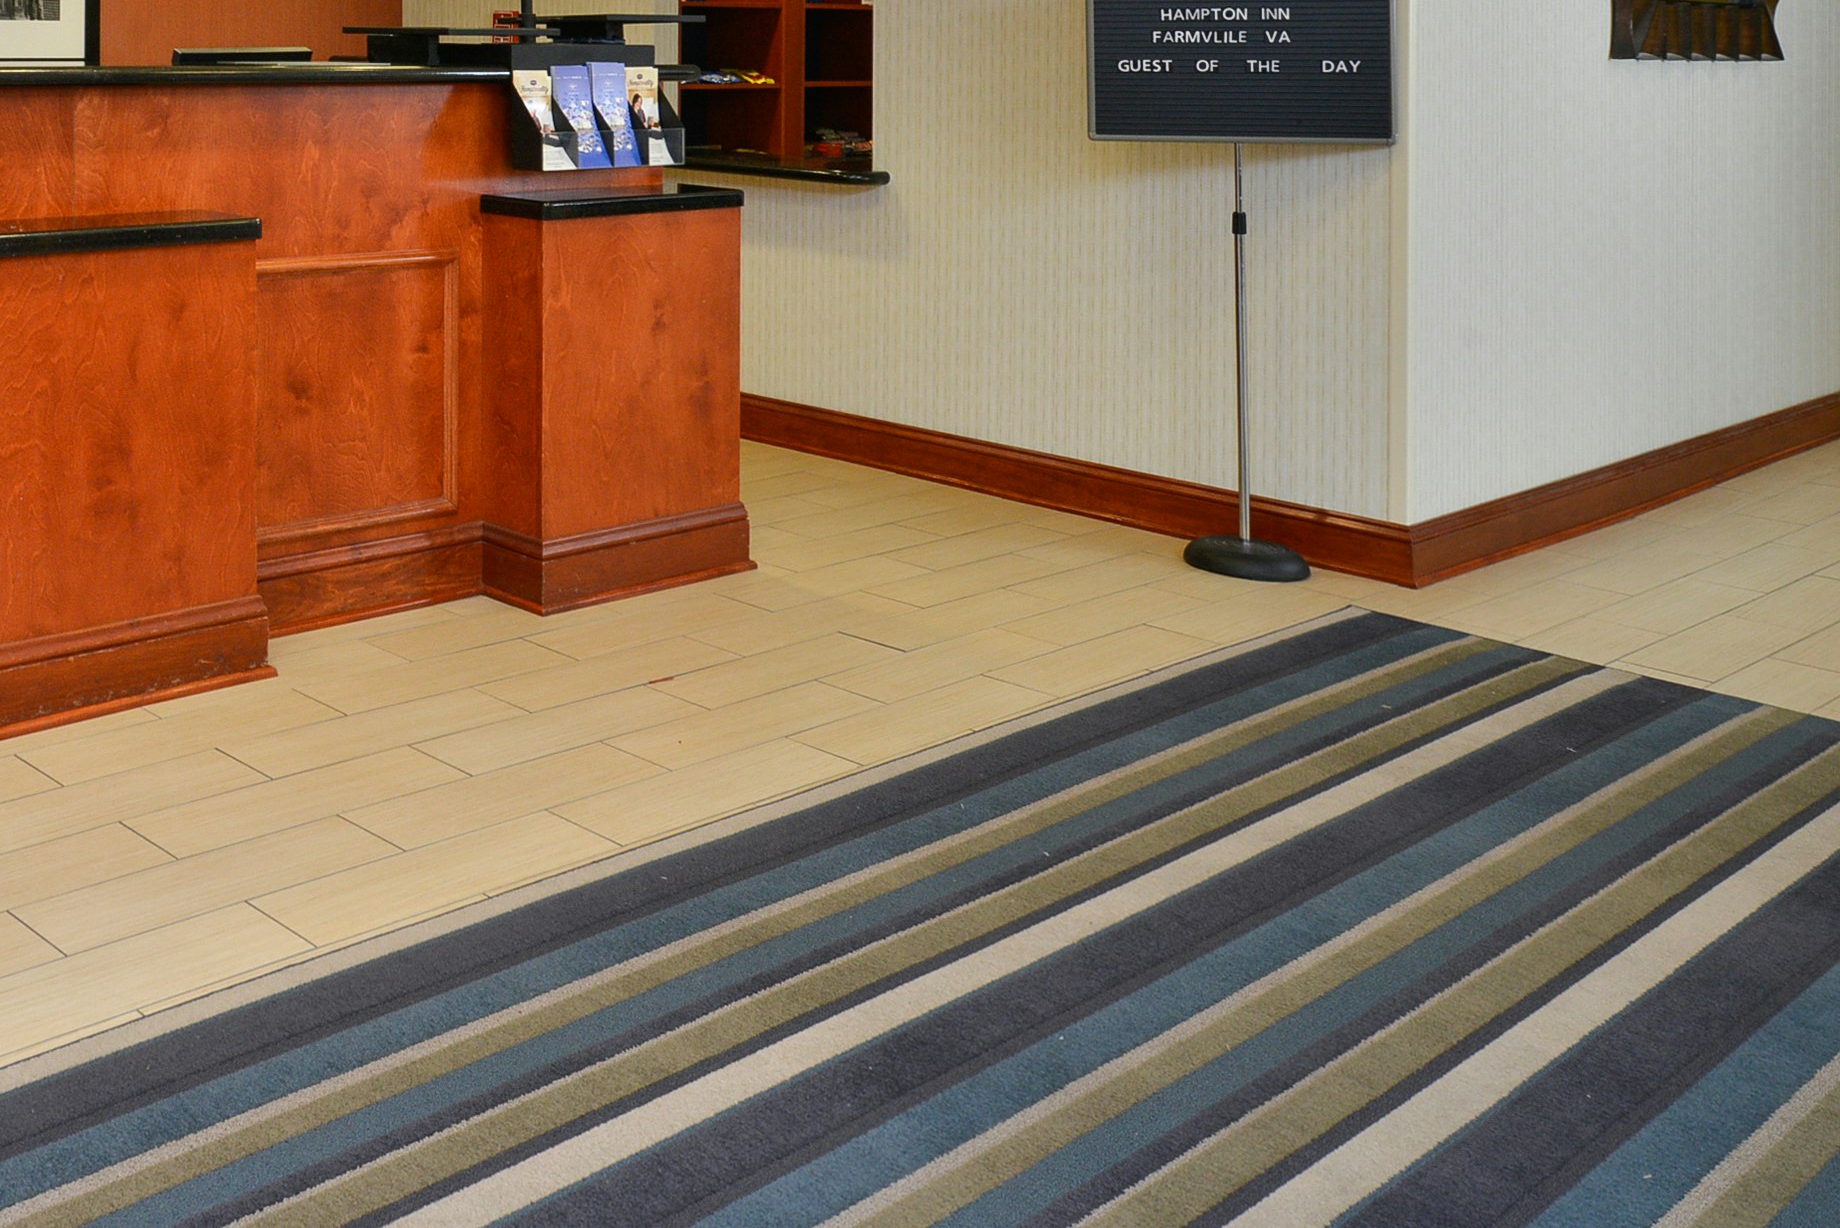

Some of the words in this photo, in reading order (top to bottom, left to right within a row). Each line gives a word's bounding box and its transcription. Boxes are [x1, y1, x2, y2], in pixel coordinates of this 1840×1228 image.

[1160, 7, 1248, 21] HAMPTON
[1261, 7, 1290, 20] INN
[1152, 30, 1248, 44] FARMVLILE
[1265, 30, 1291, 44] VA
[1117, 59, 1173, 73] GUEST
[1195, 59, 1219, 73] OF
[1246, 59, 1280, 73] THE
[1322, 59, 1362, 73] DAY
